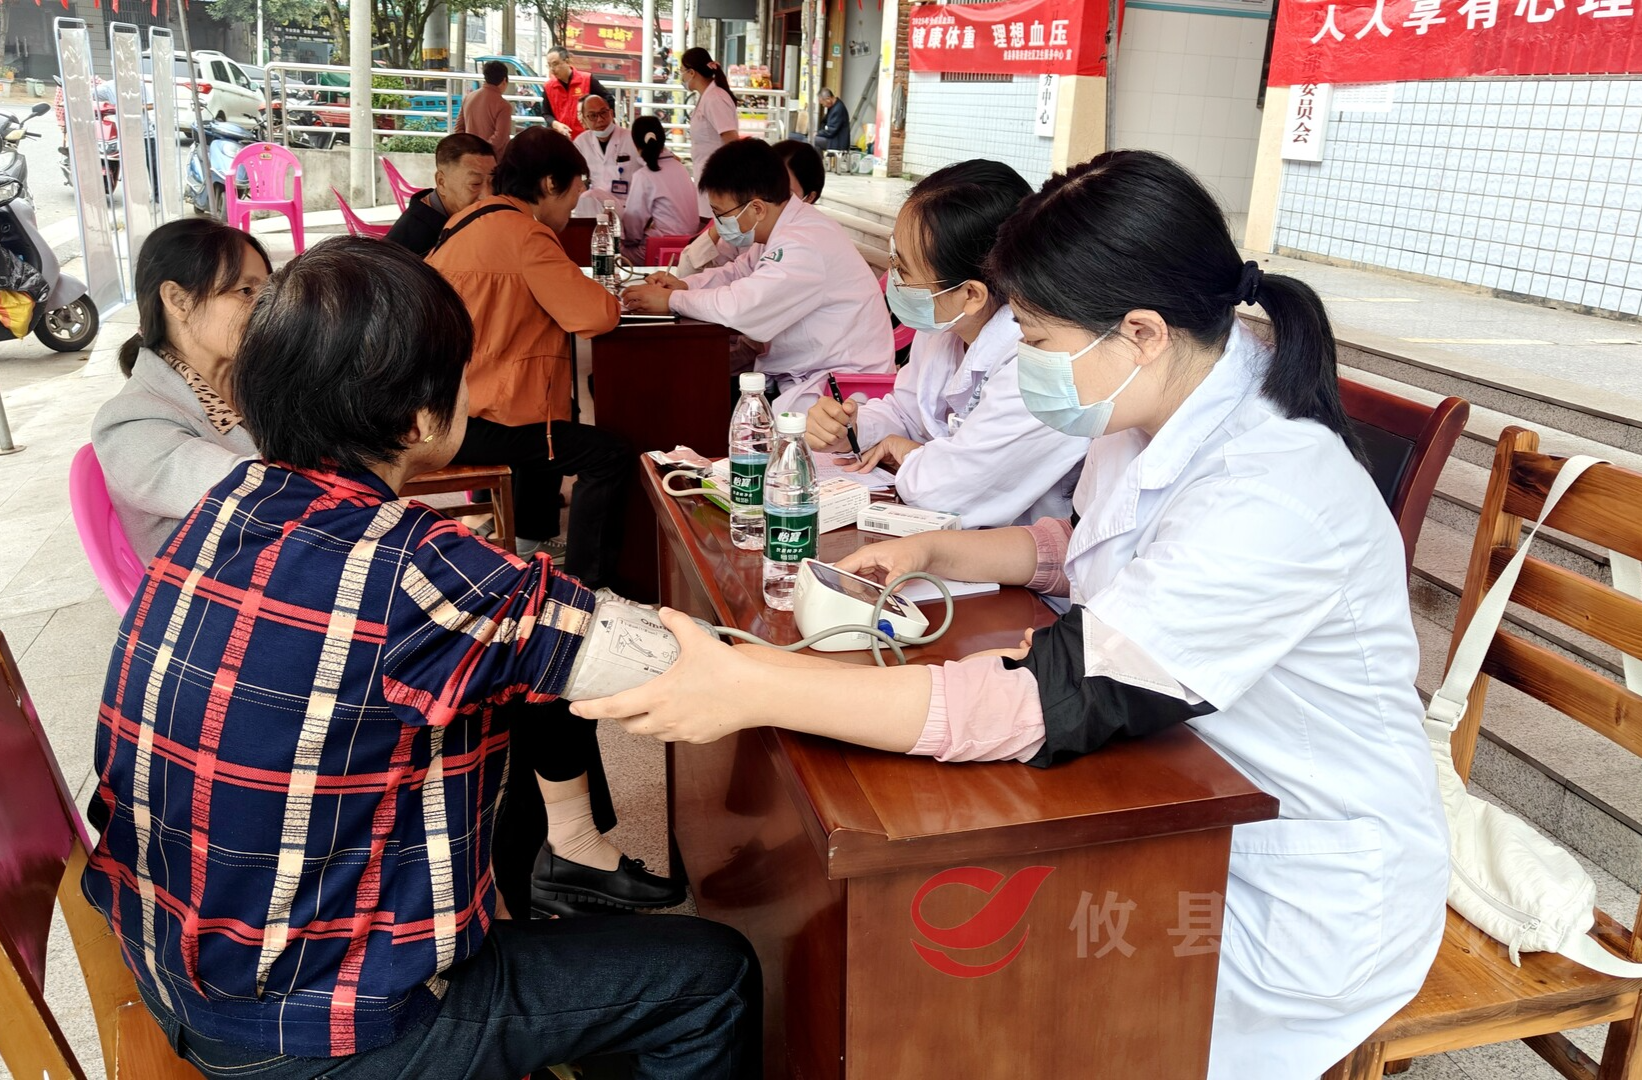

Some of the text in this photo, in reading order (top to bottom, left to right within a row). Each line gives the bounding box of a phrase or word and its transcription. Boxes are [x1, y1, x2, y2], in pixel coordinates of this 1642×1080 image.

[912, 20, 1069, 49] 健康体重 理想血压
